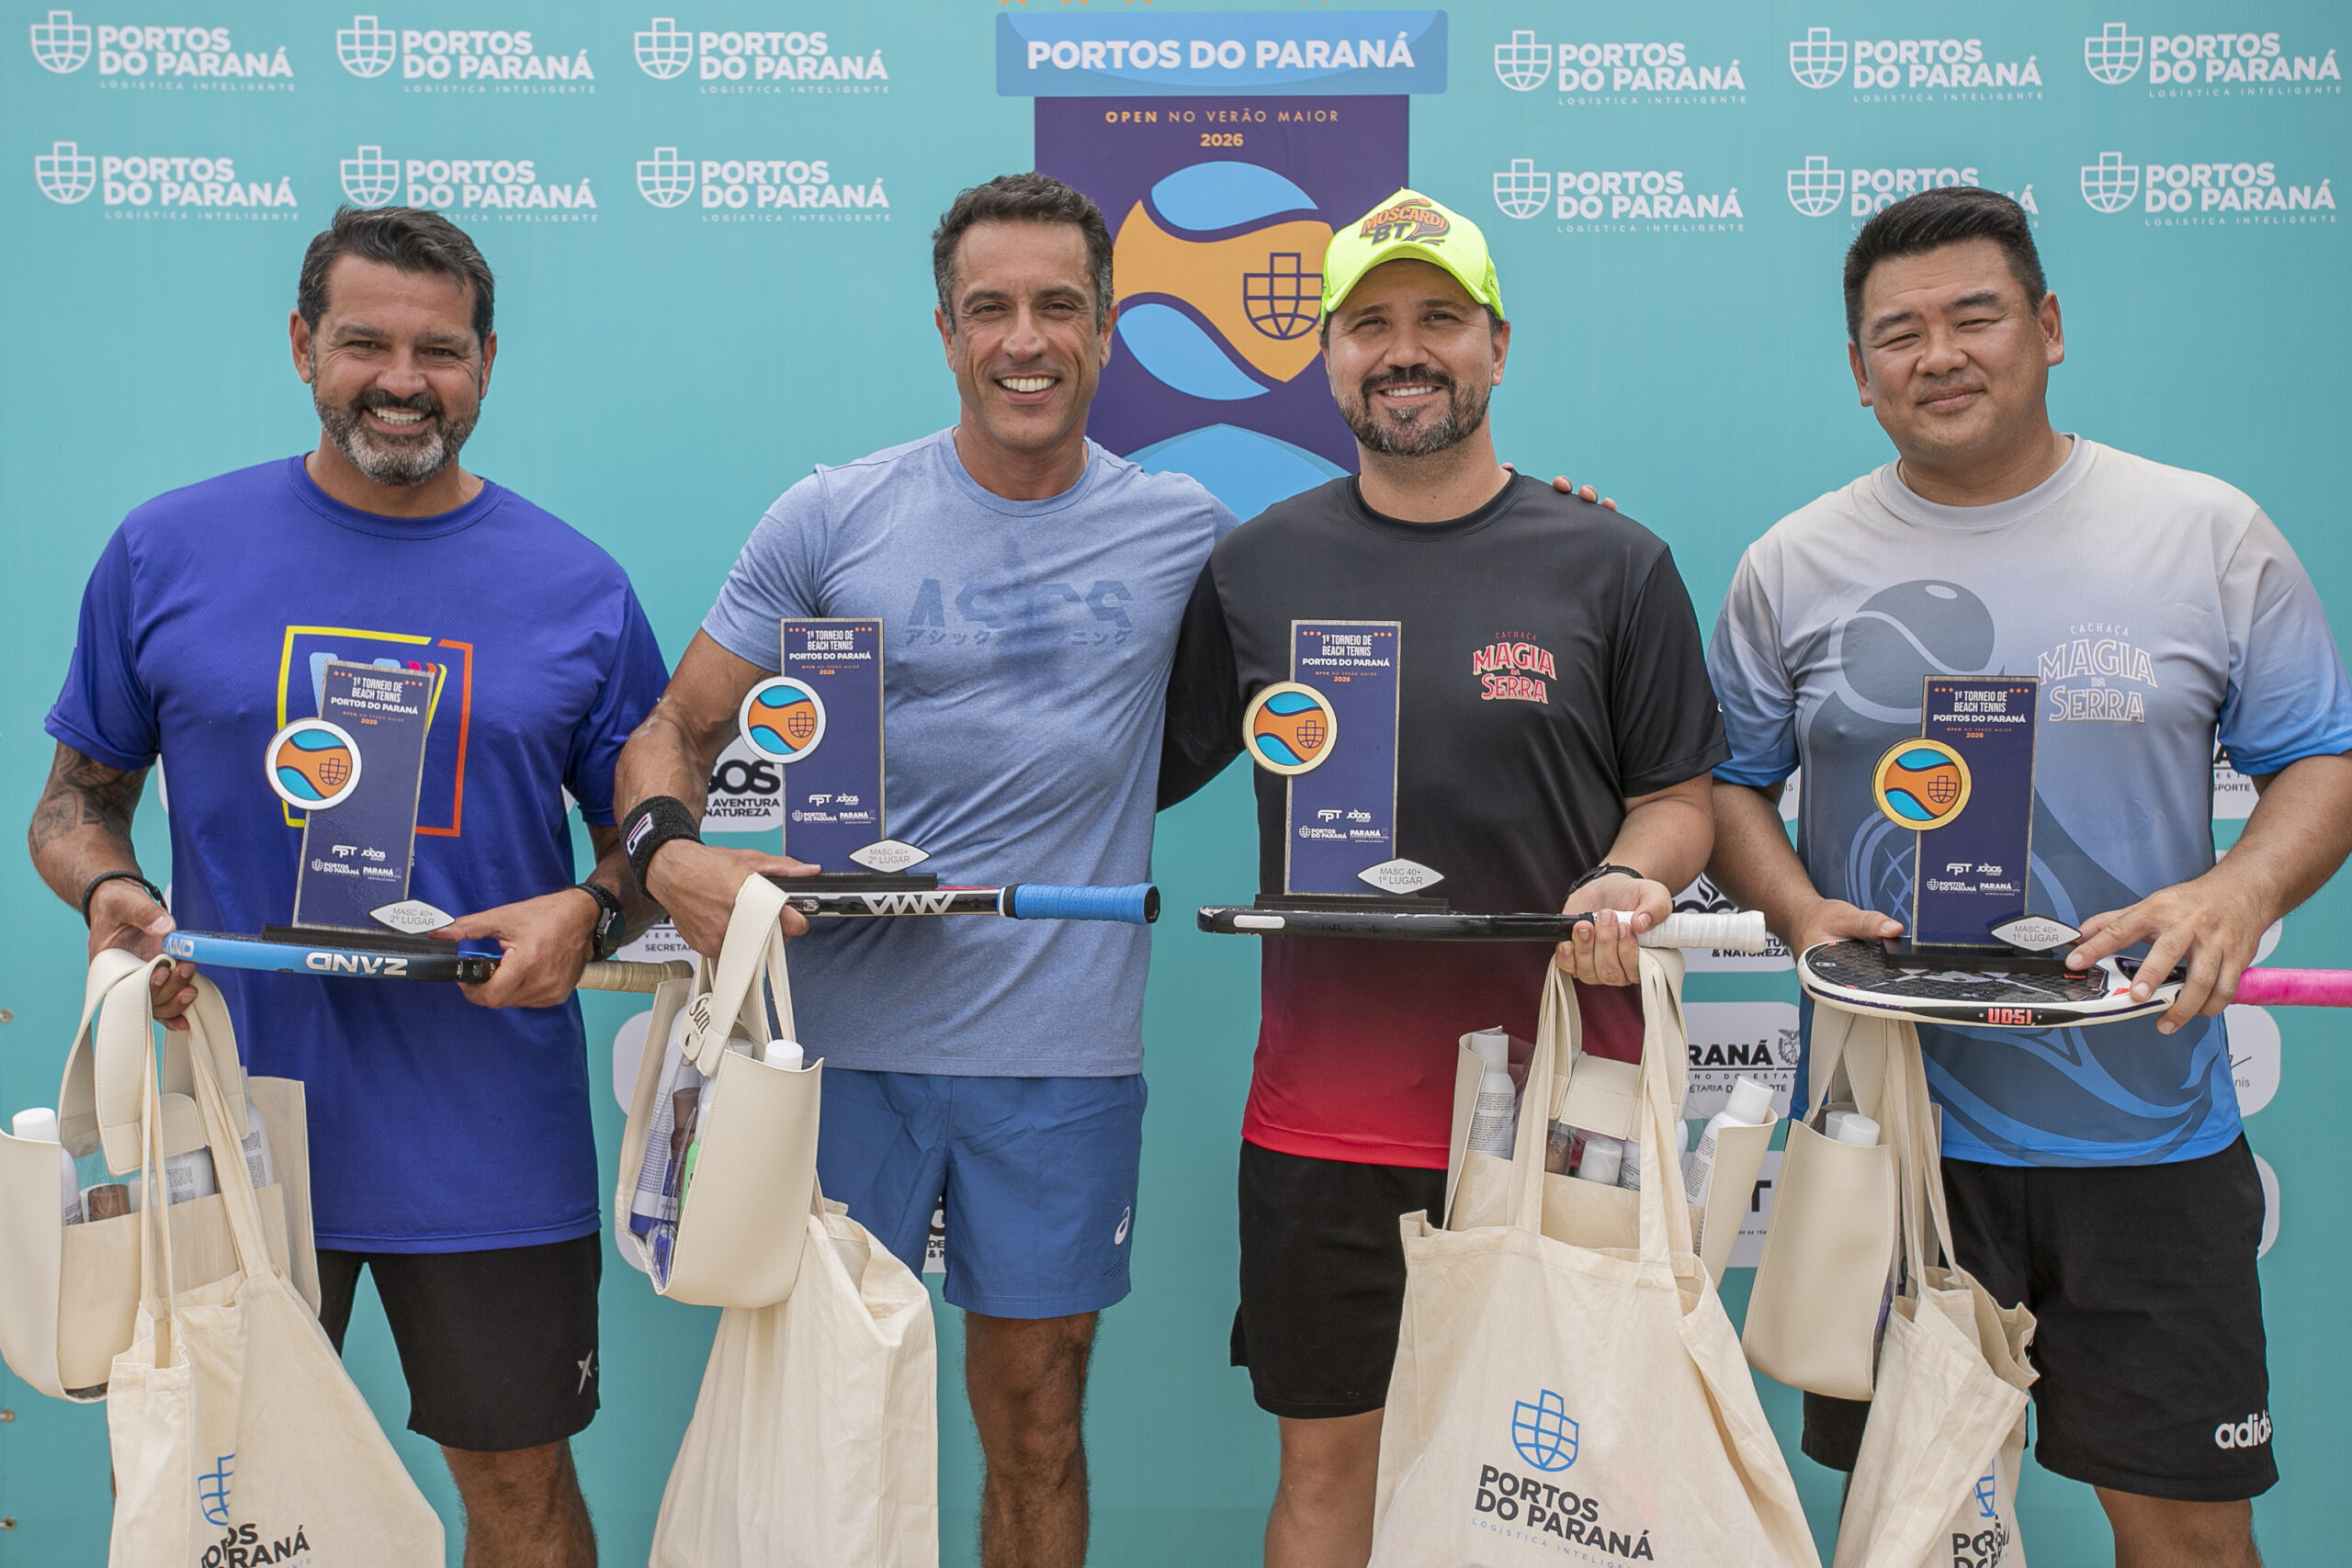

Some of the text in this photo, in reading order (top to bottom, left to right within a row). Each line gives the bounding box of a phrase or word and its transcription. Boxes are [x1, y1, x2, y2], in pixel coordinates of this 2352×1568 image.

[98, 26, 231, 52] PORTOS
[401, 30, 533, 55] PORTOS
[699, 31, 829, 55] PORTOS
[1027, 31, 1415, 70] PORTOS DO PARANÁ
[2150, 32, 2280, 59] PORTOS
[99, 46, 293, 77] DO PARANÁ
[1559, 42, 1686, 67] PORTOS
[1854, 39, 1983, 64] PORTOS
[403, 49, 594, 79] DO PARANÁ
[700, 49, 888, 79] DO PARANÁ
[1558, 59, 1746, 91] DO PARANÁ
[1854, 55, 2042, 88] DO PARANÁ
[2150, 49, 2341, 84] DO PARANÁ
[404, 84, 595, 94] LOGÍSTICA INTELIGENTE
[700, 85, 781, 93] LOGÍSTICA
[1559, 96, 1746, 105] LOGÍSTICA INTELIGENTE
[1854, 92, 2042, 102] LOGÍSTICA INTELIGENTE
[2150, 86, 2342, 97] LOGÍSTICA INTELIGENTE
[1105, 108, 1339, 123] OPEN NO VERÃO MAIOR
[1200, 133, 1244, 147] 2026
[103, 156, 235, 182] PORTOS
[406, 160, 536, 184] PORTOS
[701, 161, 830, 184] PORTOS
[1851, 167, 1980, 192] PORTOS
[2145, 162, 2276, 188] PORTOS
[105, 175, 297, 207] DO PARANÁ
[407, 177, 596, 208] DO PARANÁ
[702, 177, 889, 208] DO PARANÁ
[1557, 170, 1684, 195] PORTOS
[1557, 186, 1743, 220] DO PARANÁ
[2145, 178, 2336, 212] DO PARANÁ
[703, 212, 783, 221] LOGÍSTICA
[1361, 207, 1447, 237] MOSCARDI
[1557, 224, 1635, 232] LOGÍSTICA
[2145, 214, 2337, 226] LOGÍSTICA INTELIGENTE
[1372, 221, 1413, 246] BT
[815, 630, 844, 640] TORNEIO
[844, 630, 854, 640] DE
[1331, 635, 1361, 645] TORNEIO
[1362, 635, 1373, 645] DE
[1495, 631, 1536, 641] CACHAÇA
[2070, 623, 2129, 636] CACHAÇA
[789, 652, 822, 660] PORTOS
[837, 650, 872, 660] PARANÁ
[807, 640, 854, 651] BEACH TENNIS
[1322, 646, 1372, 657] BEACH TENNIS
[1302, 658, 1338, 666] PORTOS
[1353, 658, 1391, 667] PARANÁ
[1473, 642, 1557, 681] MAGIA
[2038, 638, 2159, 689] MAGIA
[362, 677, 393, 692] TORNEIO
[392, 682, 404, 693] DE
[1481, 673, 1549, 705] SERRA
[2091, 677, 2106, 687] DA
[331, 696, 419, 715] PORTOS DO PARANÁ
[352, 687, 401, 703] BEACH TENNIS
[1963, 691, 1996, 701] TORNEIO
[1997, 692, 2007, 702] DE
[2049, 685, 2145, 724] SERRA
[1954, 702, 2006, 713] BEACH TENNIS
[1987, 714, 2026, 723] PARANÁ
[712, 798, 780, 807] AVENTURA
[878, 856, 910, 864] LUGAR
[1389, 876, 1423, 885] LUGAR
[392, 907, 434, 918] MASC 40+
[401, 916, 435, 927] LUGAR
[2024, 933, 2059, 942] LUGAR
[306, 952, 408, 976] ZAND
[689, 998, 710, 1034] Sun
[1689, 1040, 1774, 1066] RANÁ
[1479, 1464, 1599, 1522] PORTOS
[1472, 1517, 1548, 1547] LOGÍSTICA
[1475, 1488, 1654, 1561] DO PARANÁ
